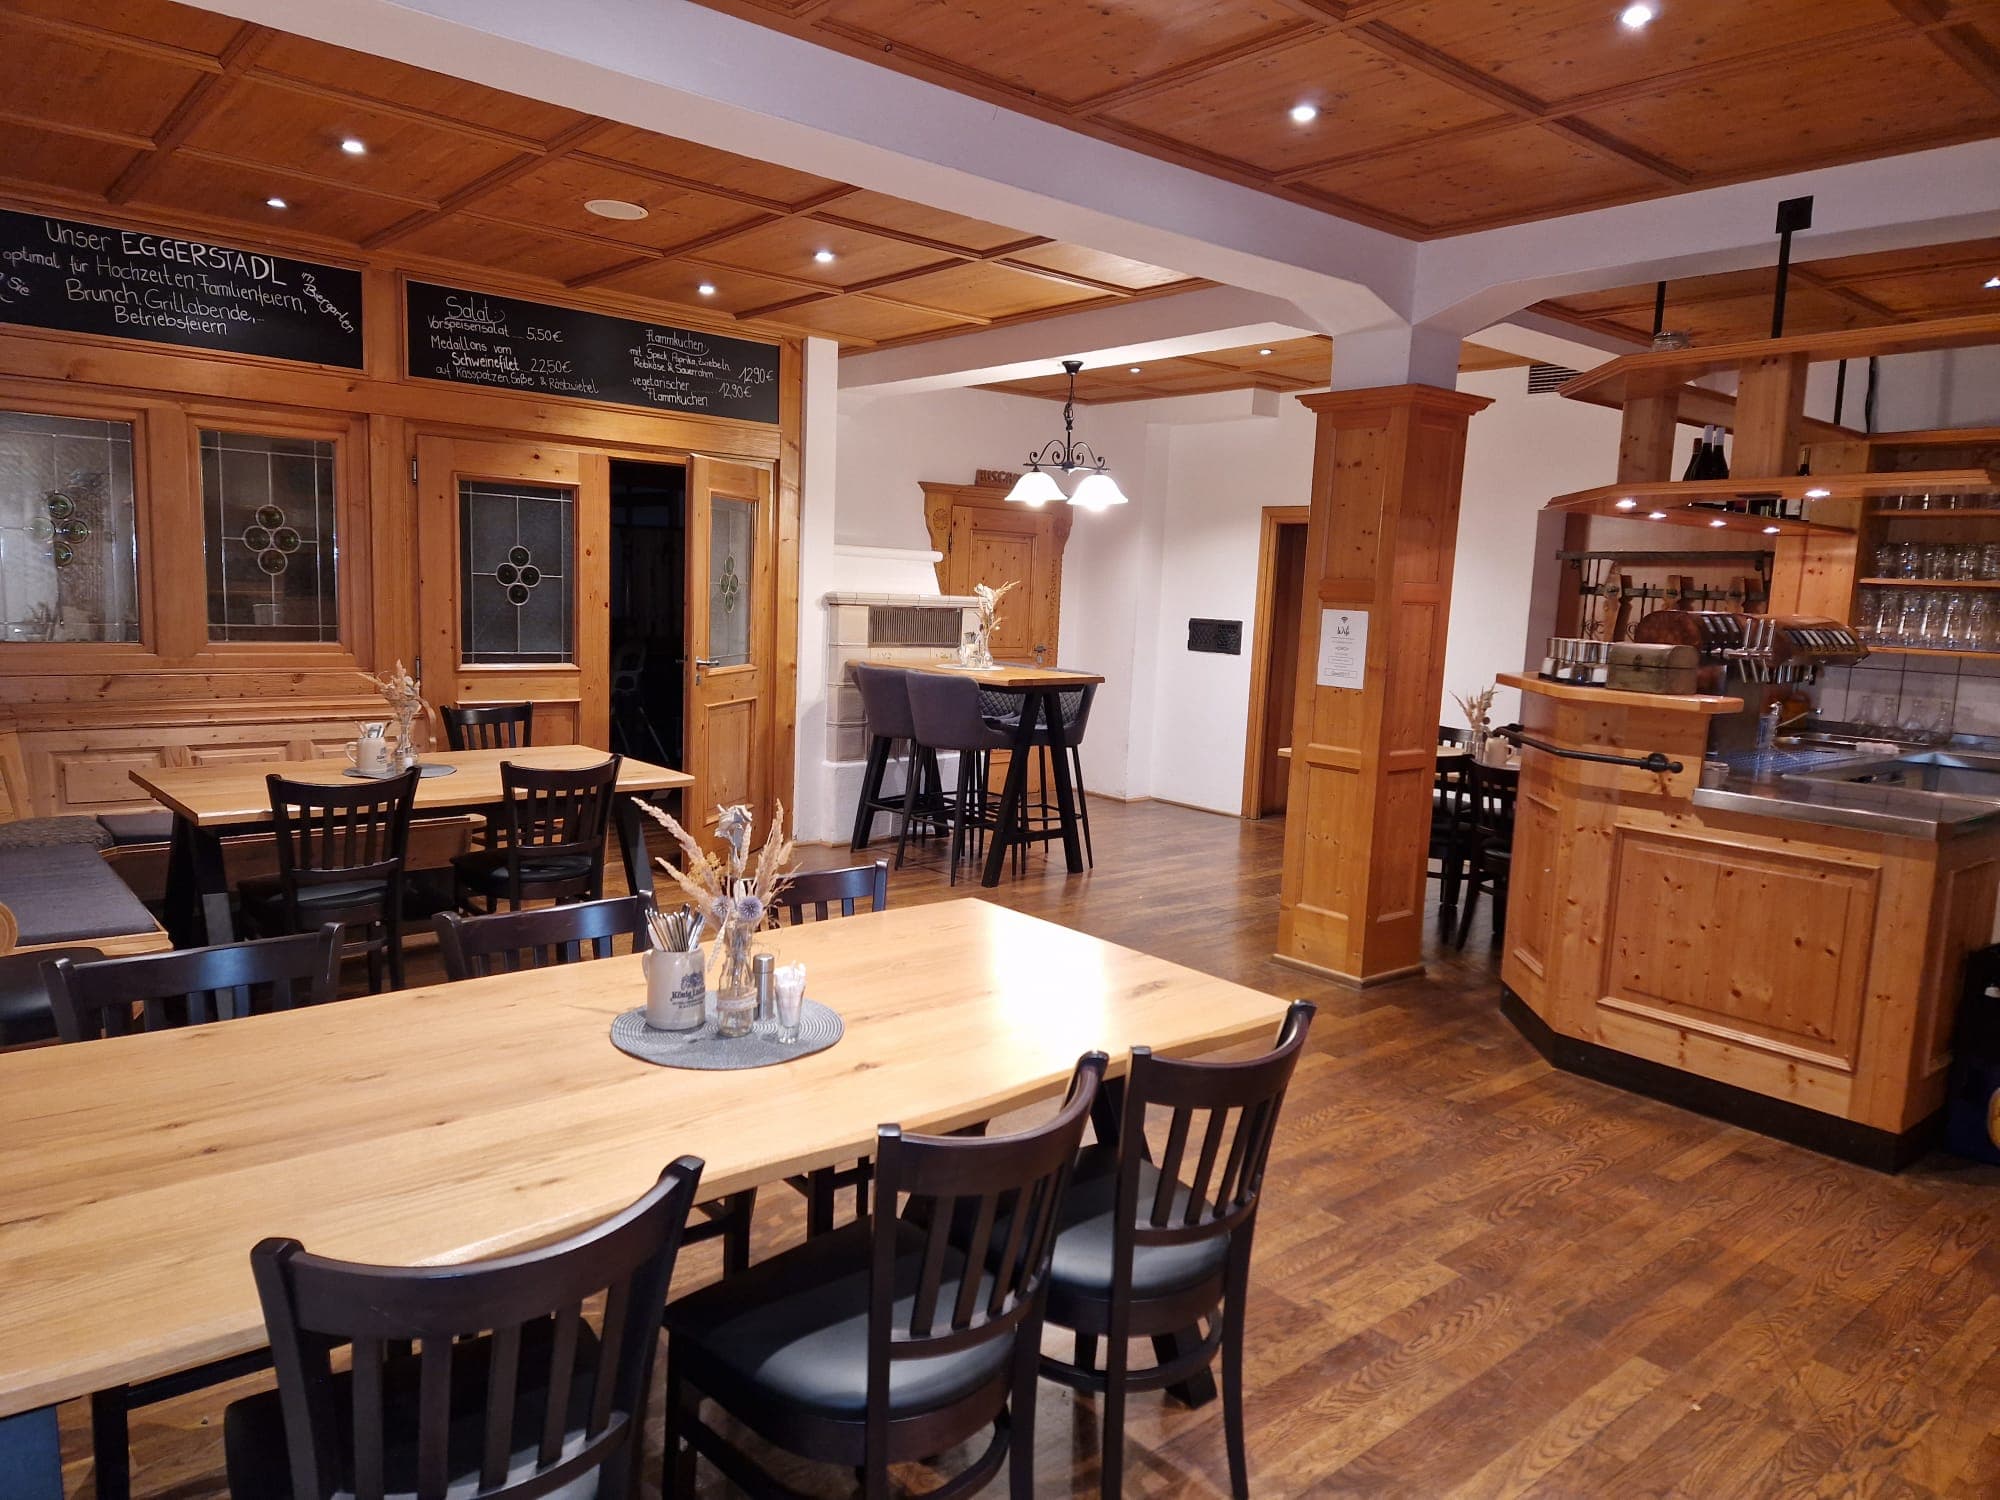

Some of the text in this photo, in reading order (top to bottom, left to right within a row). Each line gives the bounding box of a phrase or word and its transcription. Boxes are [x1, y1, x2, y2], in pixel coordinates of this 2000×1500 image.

[2, 245, 60, 268] optimal
[45, 220, 288, 286] Unser EGGERSTADL
[7, 276, 31, 296] Sie
[114, 305, 228, 336] Betriebsfeiern
[427, 314, 564, 343] Vorspeisensalat 5,50€
[430, 335, 512, 356] Medaillons vom
[435, 363, 452, 379] auf
[510, 371, 535, 386] Soße
[451, 351, 573, 375] Schweinefilet 22,50€
[667, 361, 676, 374] &
[675, 363, 714, 379] Sauerrahm
[646, 386, 708, 407] Flammkuchen
